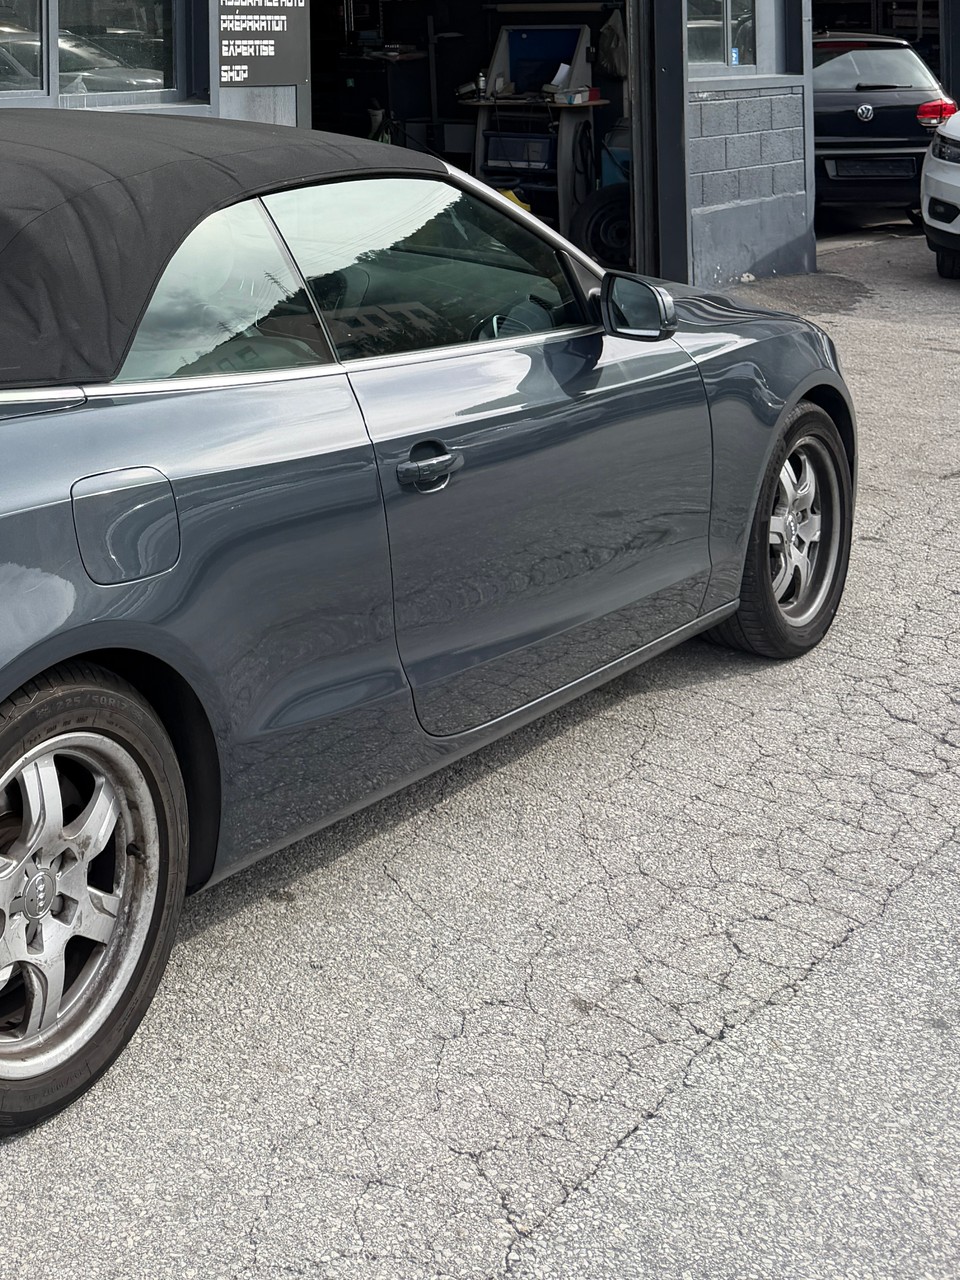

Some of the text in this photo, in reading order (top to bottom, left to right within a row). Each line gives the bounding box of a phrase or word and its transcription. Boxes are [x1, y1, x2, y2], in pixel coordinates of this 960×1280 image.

[220, 9, 287, 31] PRÉPARATION
[221, 40, 275, 56] EXPERTISE
[221, 65, 248, 82] SHOP
